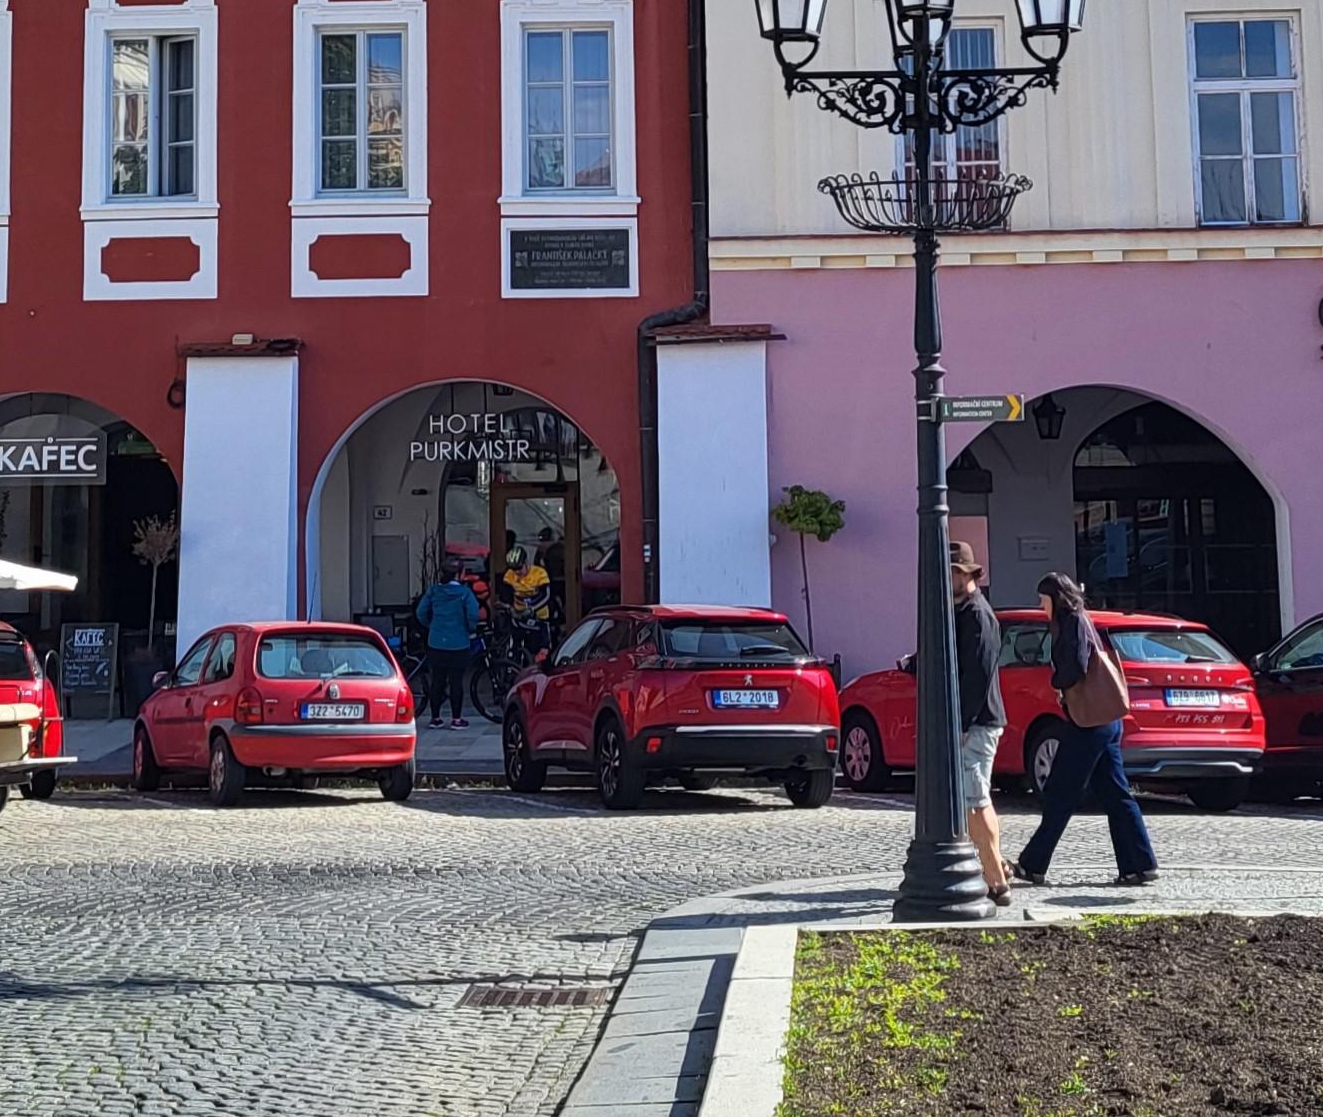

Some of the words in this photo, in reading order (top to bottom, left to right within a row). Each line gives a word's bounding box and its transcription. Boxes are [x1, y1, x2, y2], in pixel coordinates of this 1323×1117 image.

[429, 413, 509, 434] HOTEL
[410, 439, 529, 461] PURKMISTR
[723, 692, 742, 703] 6L2
[750, 692, 774, 703] 2018
[310, 705, 328, 717] 3Z2
[336, 705, 359, 717] 5470
